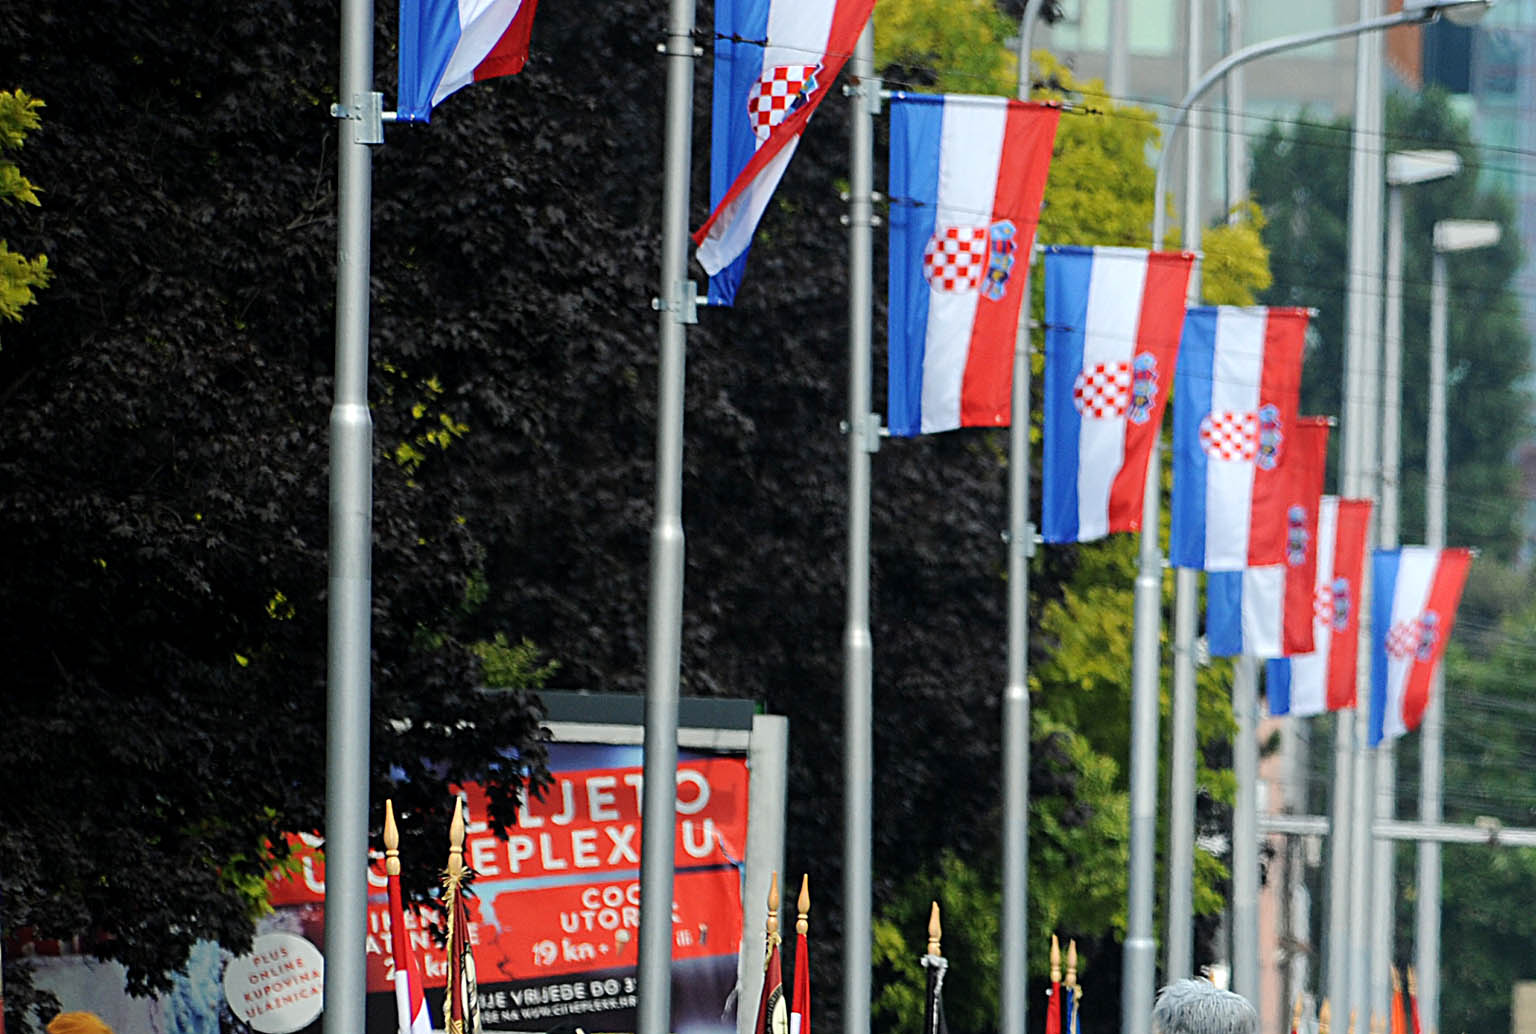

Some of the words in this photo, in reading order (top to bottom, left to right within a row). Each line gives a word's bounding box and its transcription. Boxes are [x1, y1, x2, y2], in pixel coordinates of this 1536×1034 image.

[253, 946, 288, 967] PLUS
[532, 939, 558, 966] 19
[249, 957, 303, 985] ONLINE
[244, 969, 320, 1002] KUPOVINA
[510, 982, 588, 1007] VRIJEDE
[589, 978, 621, 998] DO
